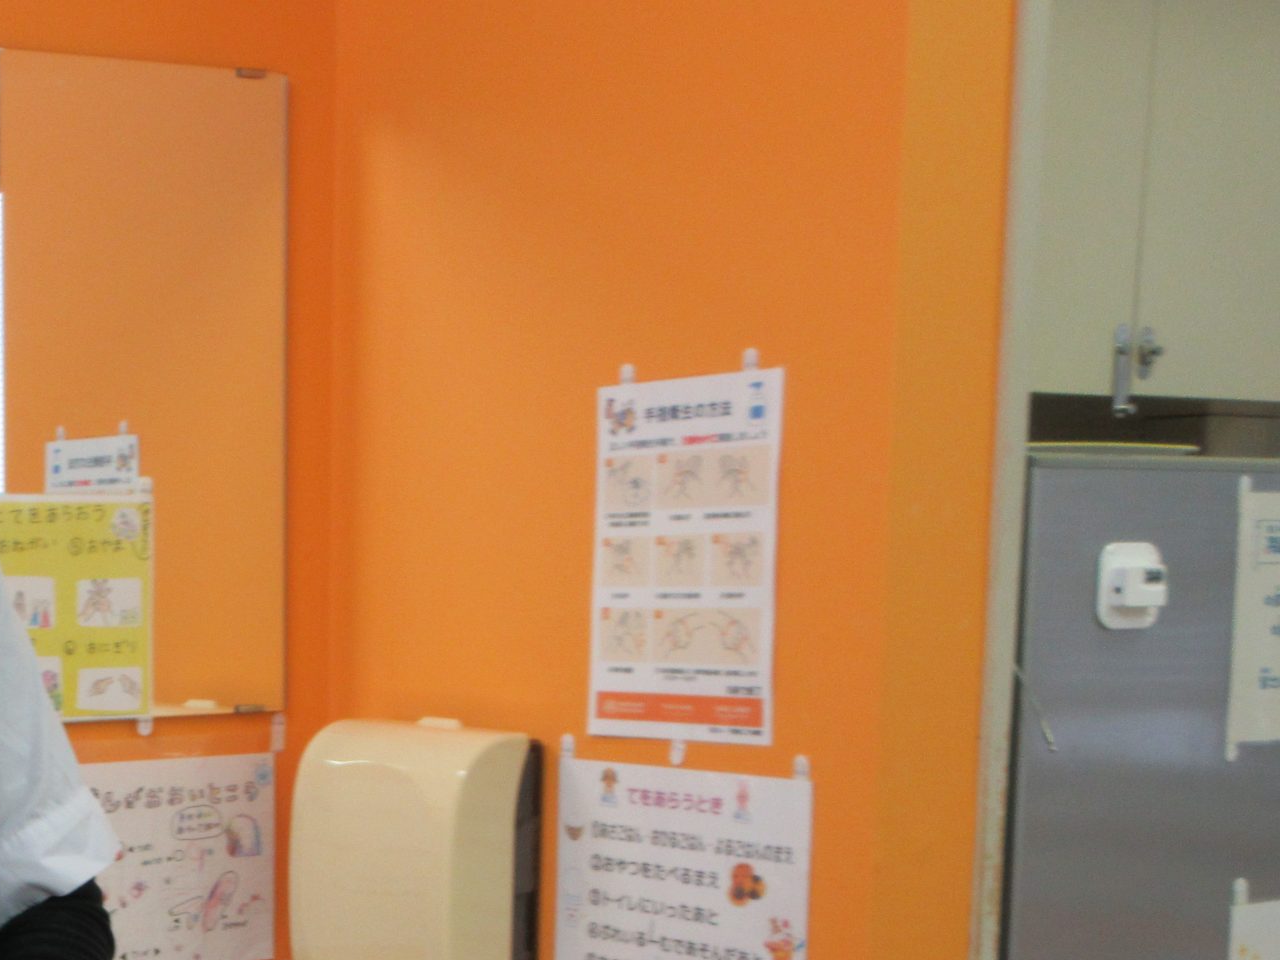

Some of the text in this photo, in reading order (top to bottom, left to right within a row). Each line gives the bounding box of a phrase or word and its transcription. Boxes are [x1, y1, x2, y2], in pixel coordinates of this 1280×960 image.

[626, 787, 723, 815] てをあらうとき
